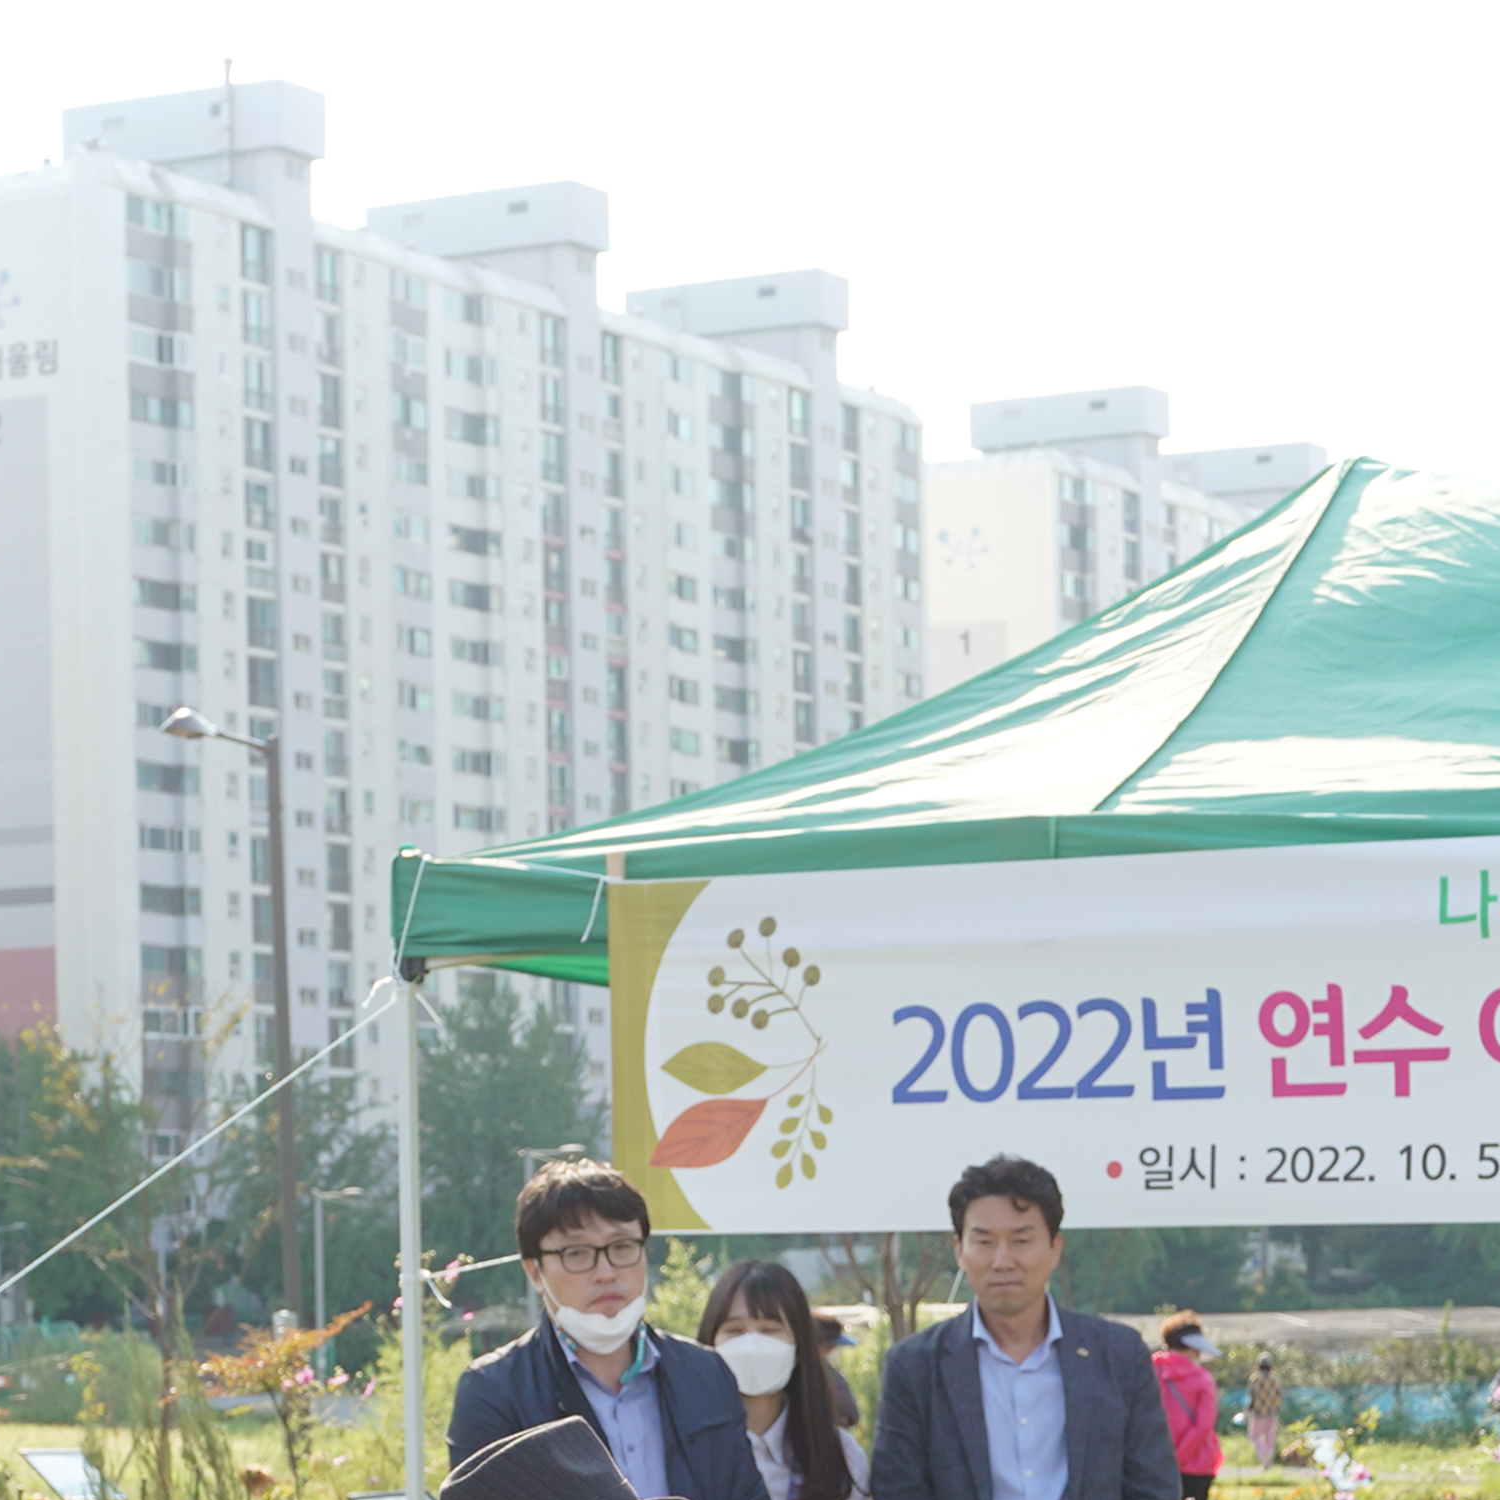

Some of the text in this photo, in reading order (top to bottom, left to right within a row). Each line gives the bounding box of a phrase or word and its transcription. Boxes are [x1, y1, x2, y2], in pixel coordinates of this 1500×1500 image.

[959, 628, 971, 656] 1
[891, 987, 1228, 1105] 2022년
[1258, 983, 1453, 1100] 연수
[1138, 1143, 1218, 1191] 일시
[1263, 1145, 1377, 1184] 2022.
[1398, 1142, 1458, 1182] 10.
